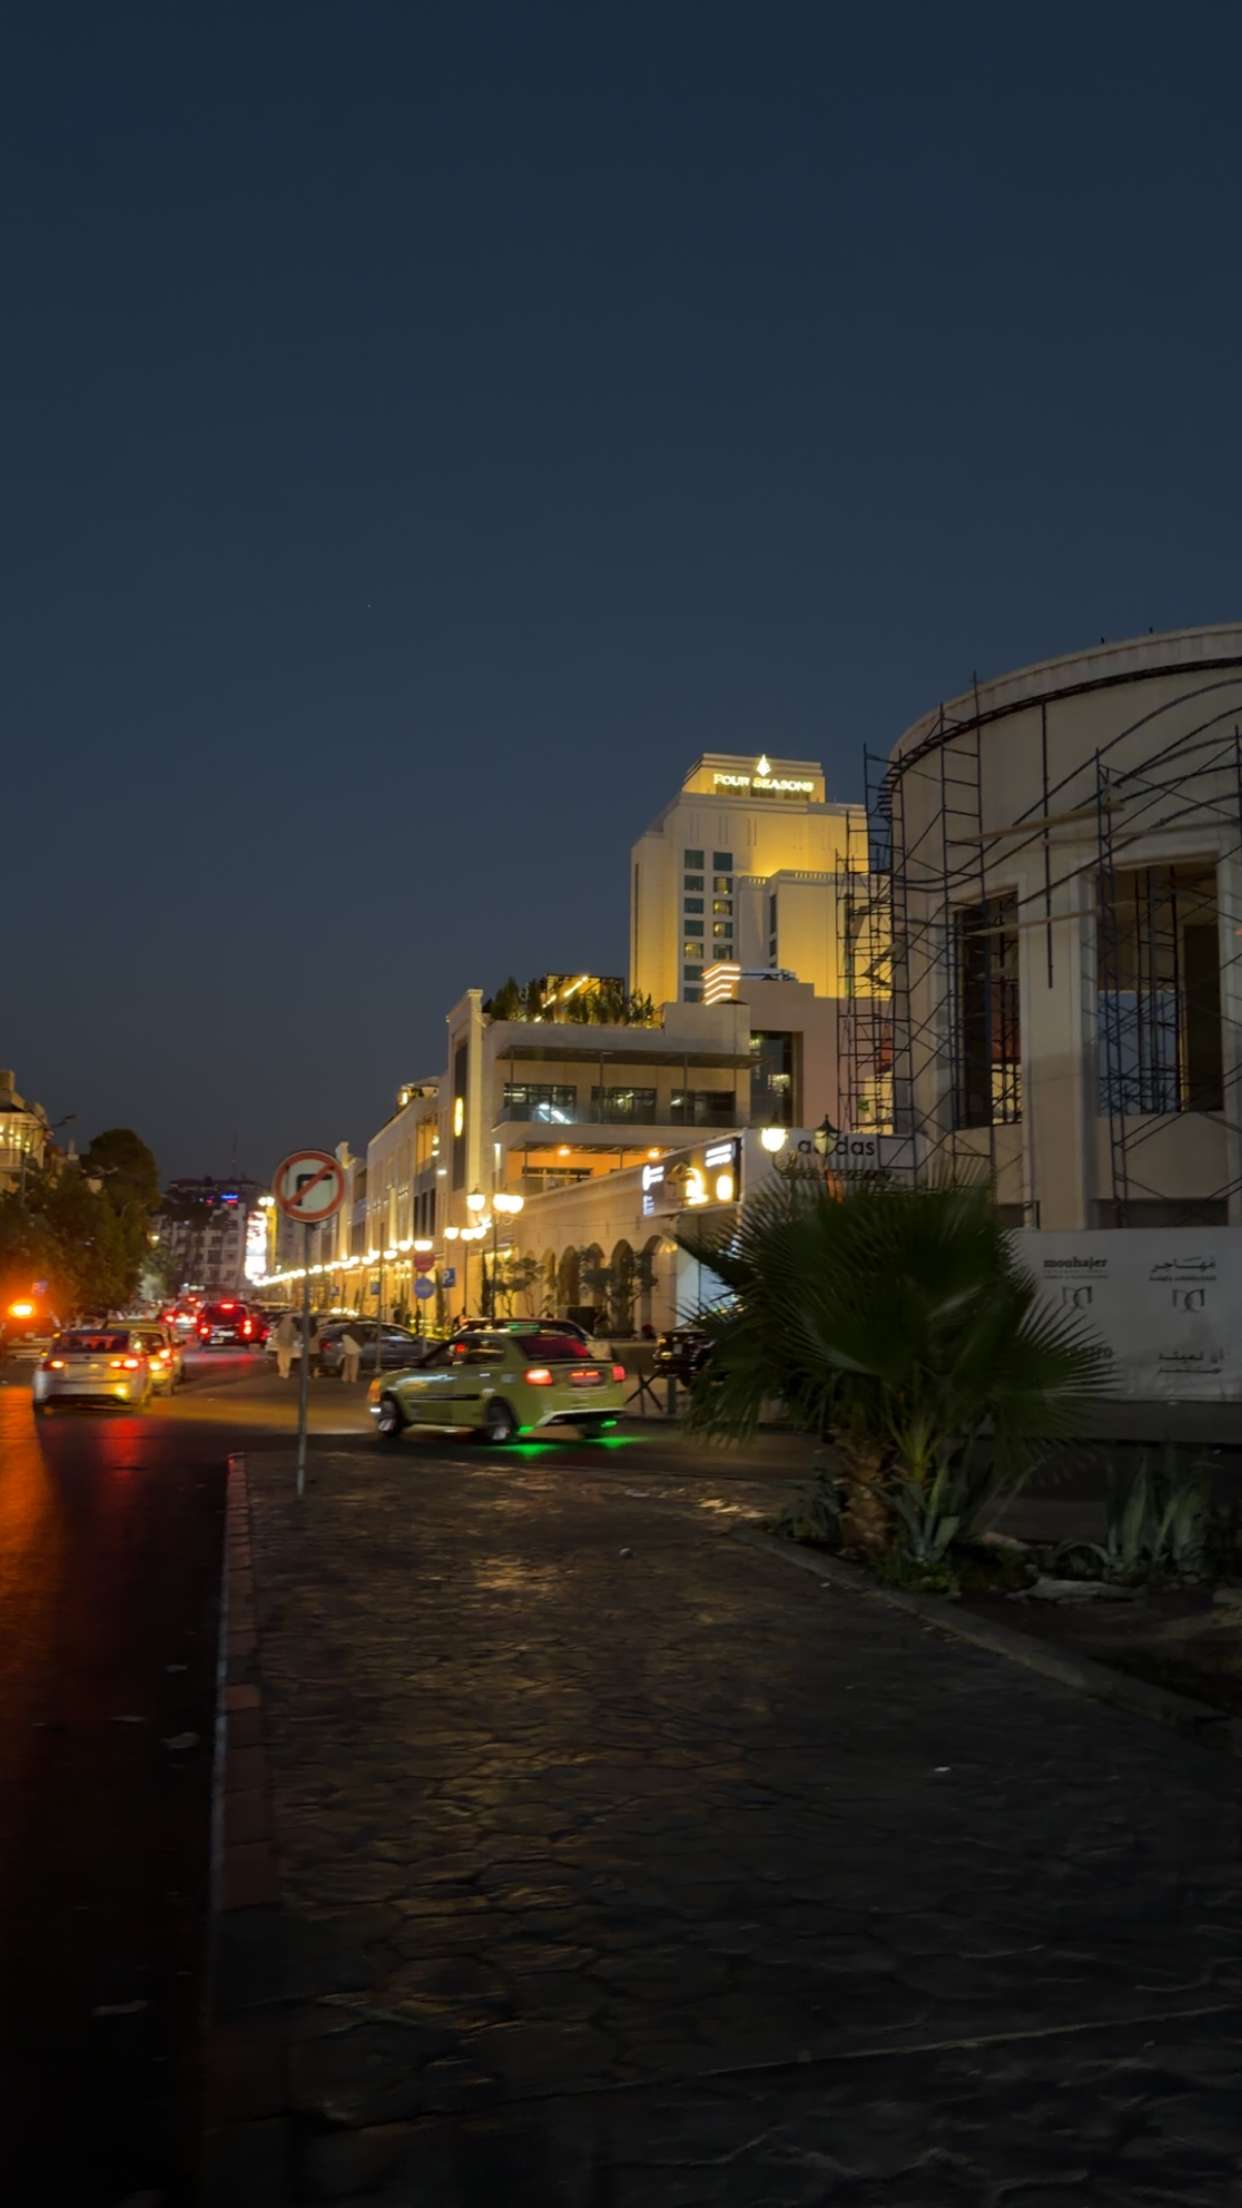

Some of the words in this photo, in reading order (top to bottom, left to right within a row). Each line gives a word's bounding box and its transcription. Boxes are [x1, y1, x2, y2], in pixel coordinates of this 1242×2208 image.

[713, 773, 750, 787] FOUR
[752, 777, 815, 793] SEASONS
[798, 1136, 875, 1156] adas
[1043, 1256, 1107, 1270] mouhajer
